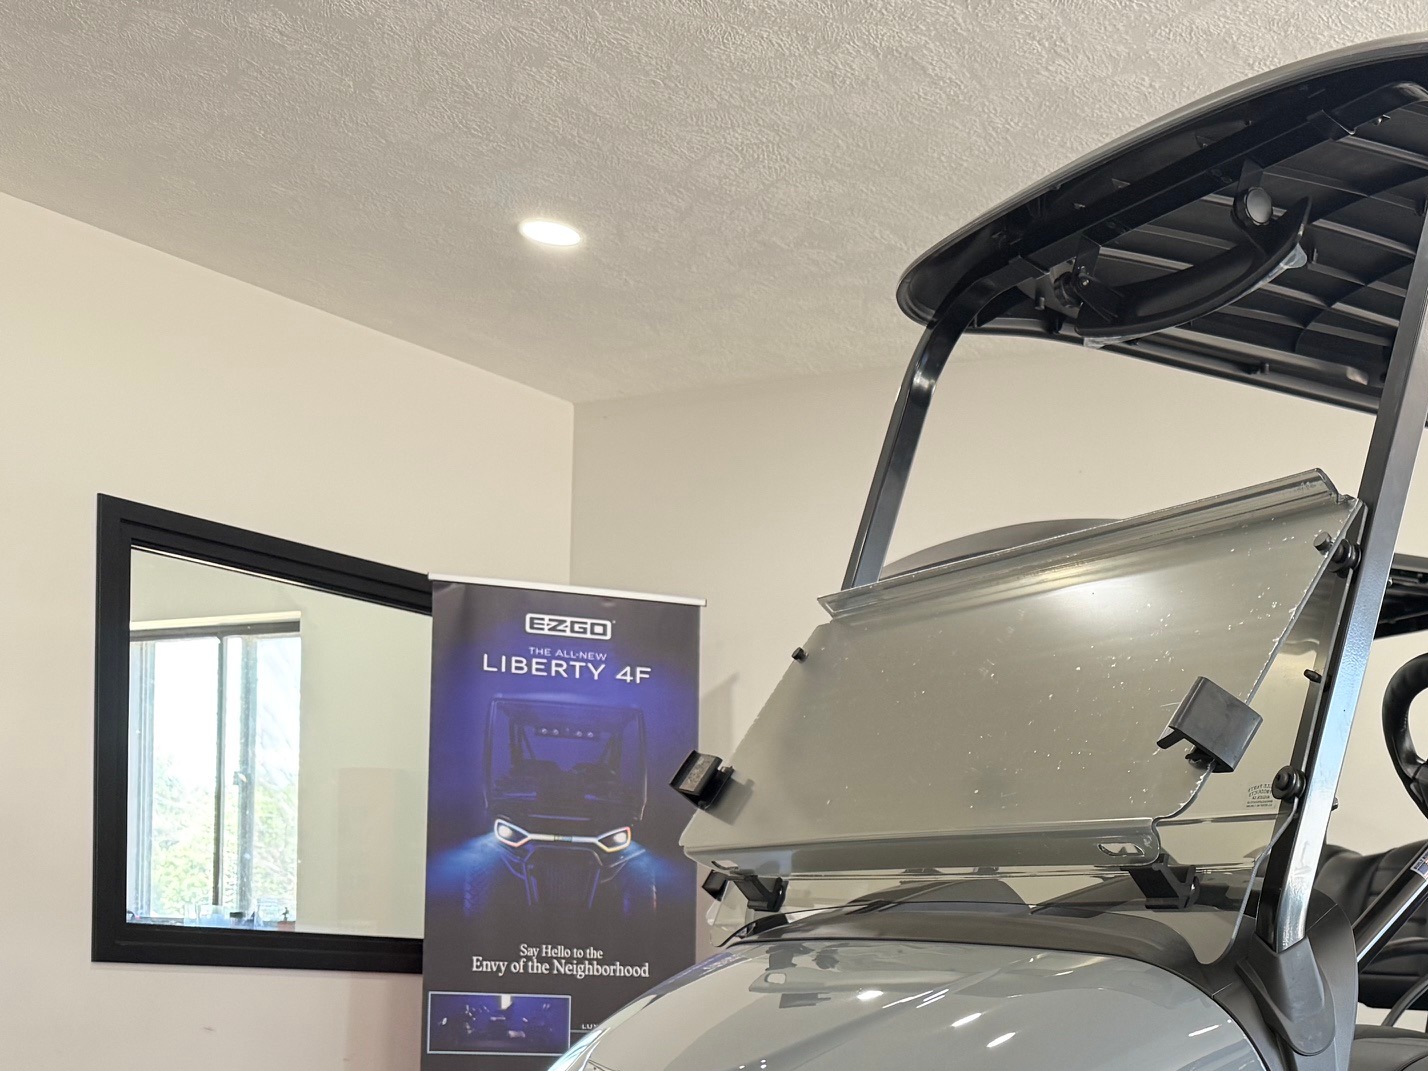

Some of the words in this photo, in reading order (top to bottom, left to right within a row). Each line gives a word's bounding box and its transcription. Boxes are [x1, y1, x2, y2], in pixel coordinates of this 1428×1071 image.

[528, 615, 609, 638] EZGO
[528, 646, 552, 657] THE
[555, 649, 607, 661] ALL-NEW
[483, 653, 606, 681] LIBERTY
[615, 666, 652, 684] 4F
[520, 943, 540, 959] Say
[541, 944, 571, 958] Hello
[573, 948, 584, 959] to
[586, 946, 604, 960] the
[472, 956, 508, 976] Envy
[511, 958, 525, 973] of
[528, 958, 550, 974] the
[553, 959, 650, 979] Neighborhood
